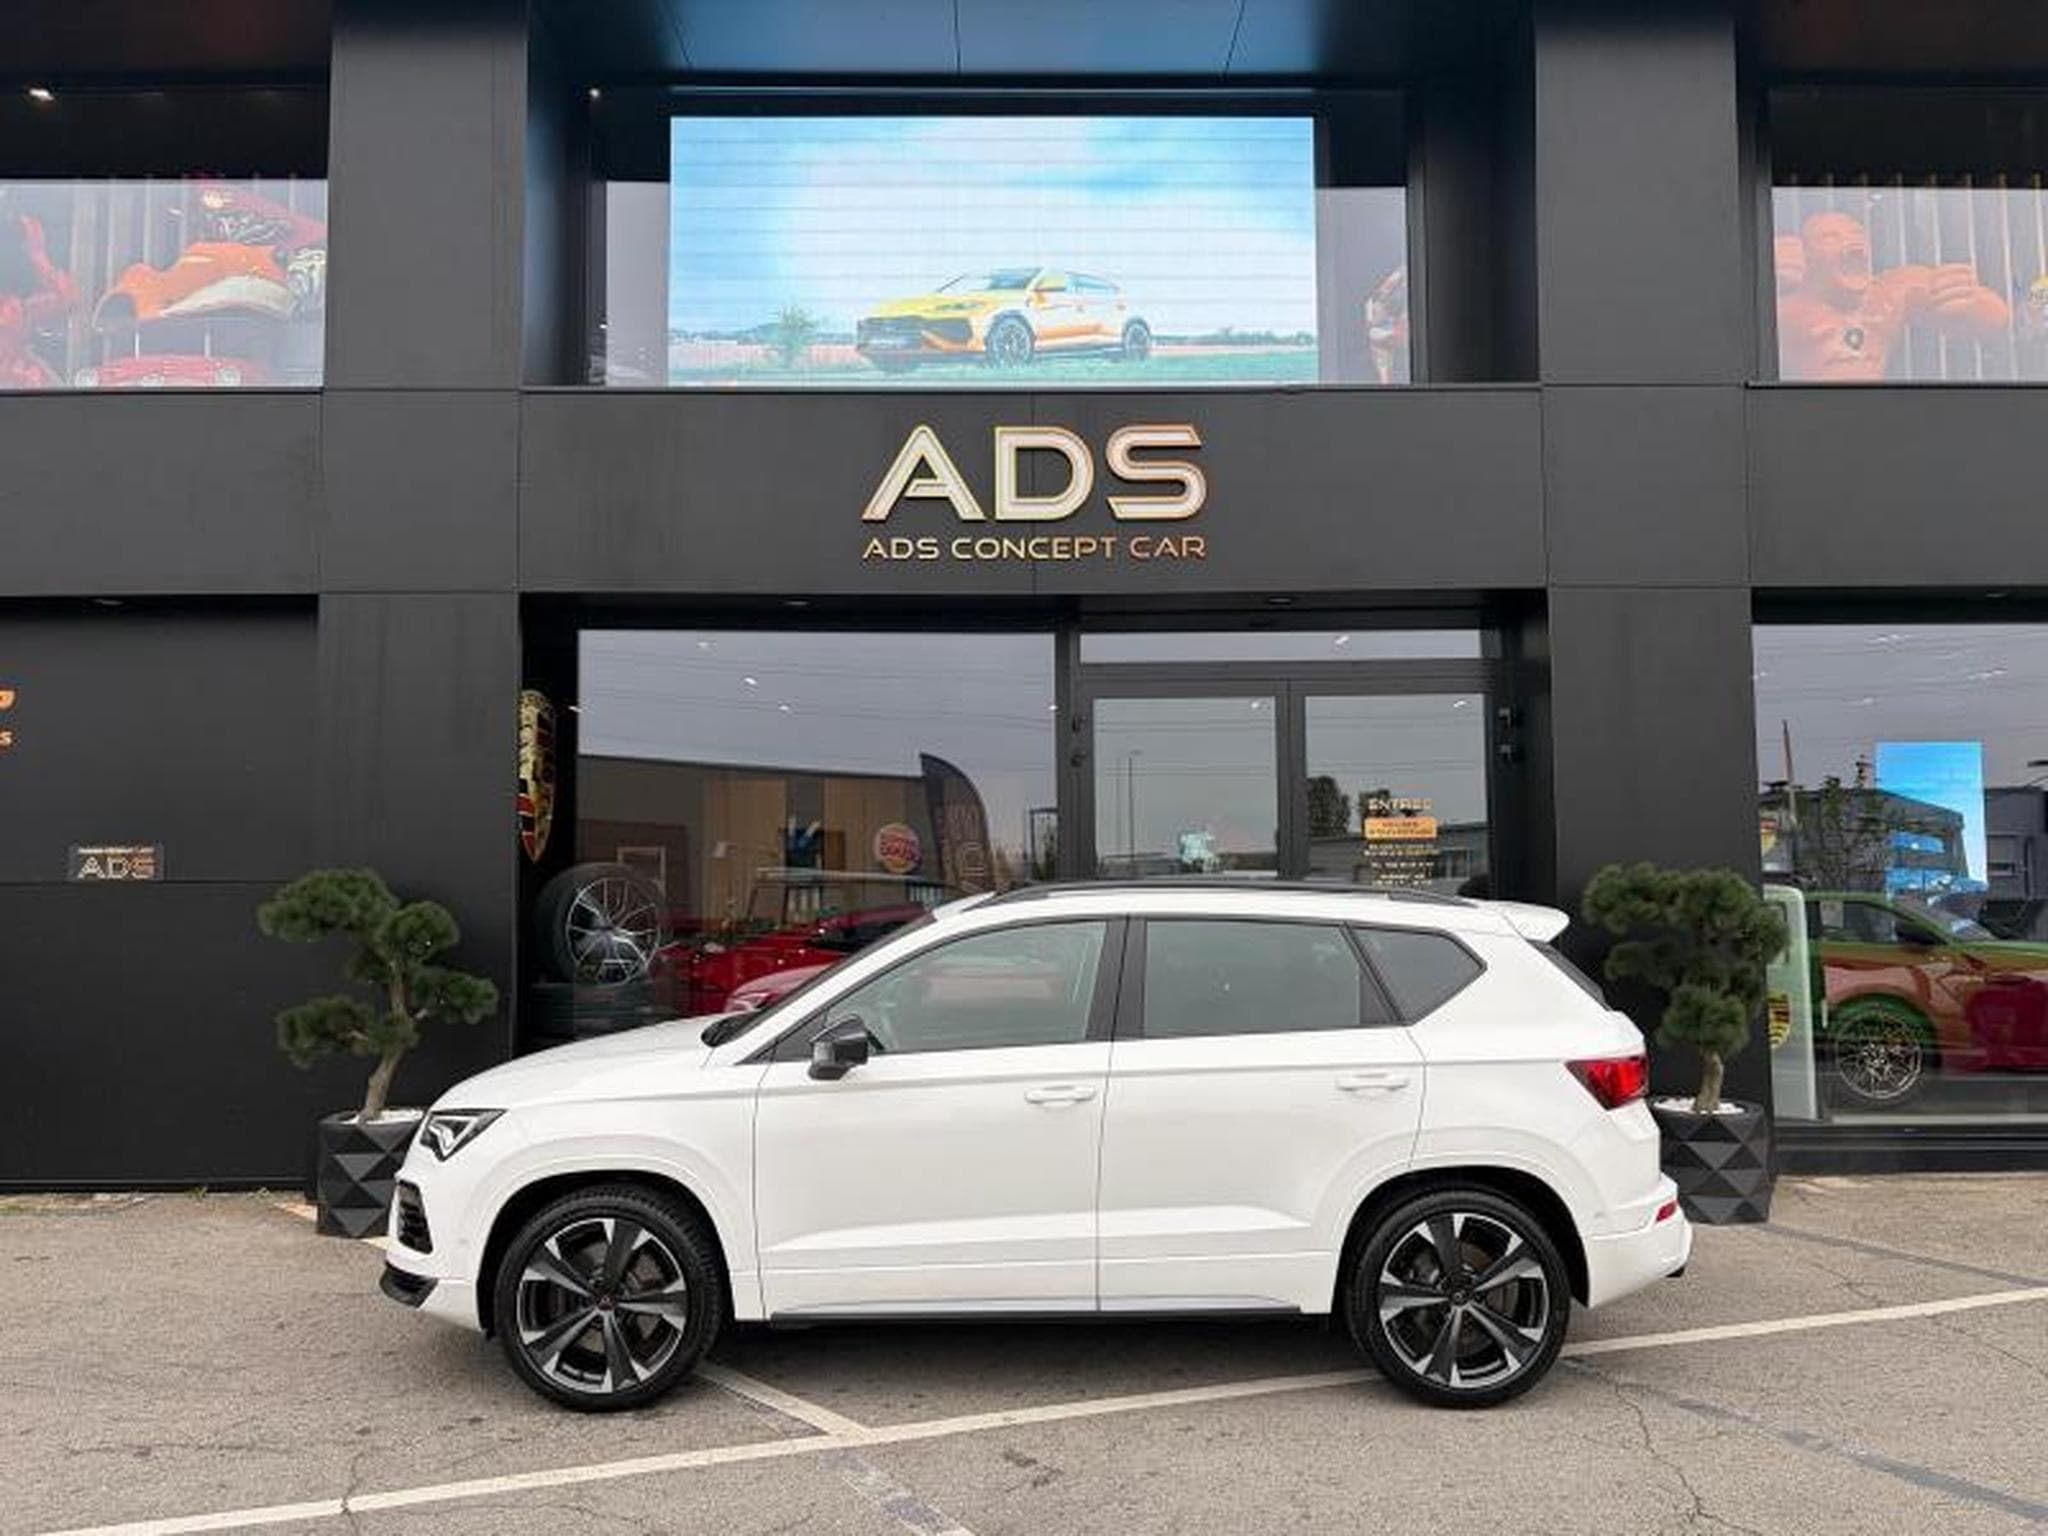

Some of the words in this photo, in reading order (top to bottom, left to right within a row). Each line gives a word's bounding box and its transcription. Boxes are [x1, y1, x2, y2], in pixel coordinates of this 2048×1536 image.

[861, 423, 1208, 521] ADS
[862, 537, 939, 560] ADS
[951, 536, 1118, 560] CONCEPT
[1129, 535, 1207, 559] CAR
[77, 855, 156, 879] ADS
